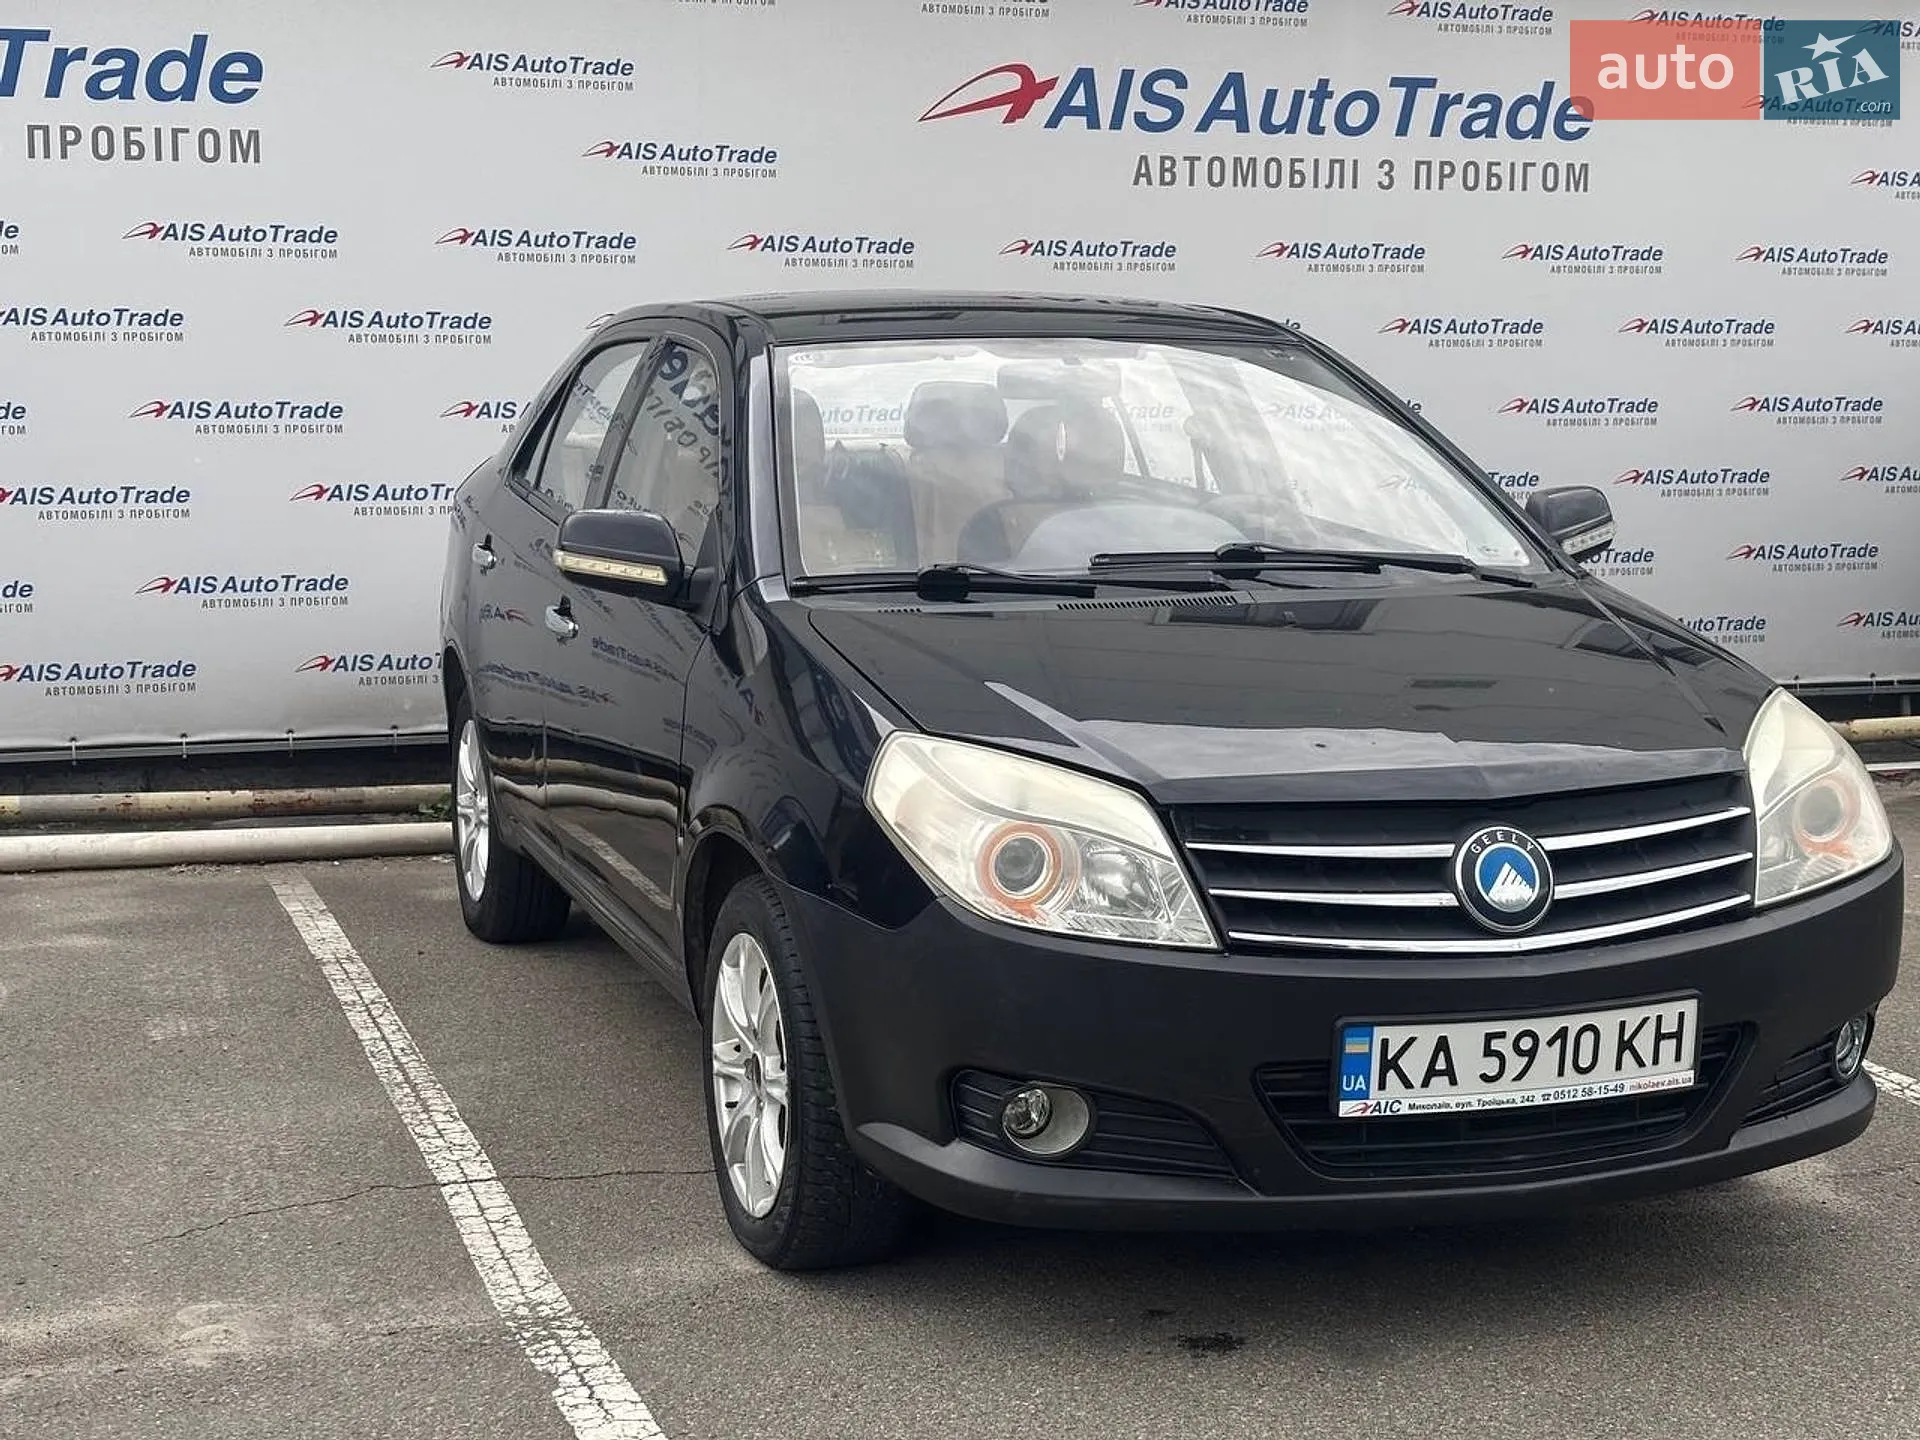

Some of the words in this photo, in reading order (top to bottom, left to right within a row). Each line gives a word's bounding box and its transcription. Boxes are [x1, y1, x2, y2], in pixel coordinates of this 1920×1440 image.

[1416, 2, 1451, 18] AIS
[1453, 3, 1553, 22] AutoTrade
[466, 53, 509, 71] AIS
[512, 55, 634, 76] AutoTrade
[1045, 66, 1188, 131] AIS
[1195, 71, 1595, 141] AutoTrade
[27, 124, 260, 163] ПРОБІГОМ
[617, 142, 657, 160] AIS
[660, 144, 777, 163] AutoTrade
[1132, 155, 1359, 189] АВТОМОБІЛІ
[1414, 160, 1590, 193] ПРОБІГОМ
[1877, 171, 1908, 187] AIS
[164, 223, 205, 241] AIS
[208, 224, 338, 243] AutoTrade
[470, 229, 512, 247] AIS
[516, 230, 636, 249] AutoTrade
[760, 236, 799, 252] AIS
[802, 236, 914, 254] AutoTrade
[1030, 240, 1067, 256] AIS
[1070, 240, 1176, 258] AutoTrade
[1286, 243, 1321, 258] AIS
[1324, 243, 1425, 259] AutoTrade
[1530, 245, 1564, 260] AIS
[1566, 245, 1663, 261] AutoTrade
[1763, 248, 1794, 262] AIS
[1796, 248, 1888, 264] AutoTrade
[2, 308, 47, 326] AIS
[50, 308, 183, 326] AutoTrade
[322, 311, 364, 328] AIS
[366, 311, 492, 329] AutoTrade
[1407, 319, 1442, 334] AIS
[1444, 318, 1543, 334] AutoTrade
[1644, 319, 1679, 334] AIS
[1680, 319, 1774, 334] AutoTrade
[1872, 320, 1902, 335] AIS
[166, 401, 212, 419] AIS
[214, 402, 343, 419] AutoTrade
[476, 401, 517, 419] AIS
[1526, 398, 1560, 414] AIS
[1561, 398, 1658, 413] AutoTrade
[1758, 397, 1790, 412] AIS
[1791, 397, 1883, 412] AutoTrade
[1640, 470, 1674, 484] AIS
[1676, 469, 1770, 484] AutoTrade
[1867, 466, 1898, 481] AIS
[8, 487, 54, 505] AIS
[58, 486, 190, 504] AutoTrade
[328, 484, 370, 501] AIS
[1754, 545, 1785, 560] AIS
[1787, 543, 1878, 559] AutoTrade
[174, 576, 217, 594] AIS
[220, 574, 348, 593] AutoTrade
[1863, 612, 1894, 626] AIS
[16, 664, 62, 682] AIS
[64, 660, 196, 680] AutoTrade
[333, 654, 374, 672] AIS
[1470, 831, 1534, 853] GEELY
[1378, 1035, 1458, 1091] KA
[1478, 1023, 1600, 1083] 5910
[1615, 1011, 1685, 1072] KH
[1342, 1075, 1366, 1092] UA
[1553, 1089, 1578, 1100] 0512
[1581, 1083, 1625, 1097] 58-15-49
